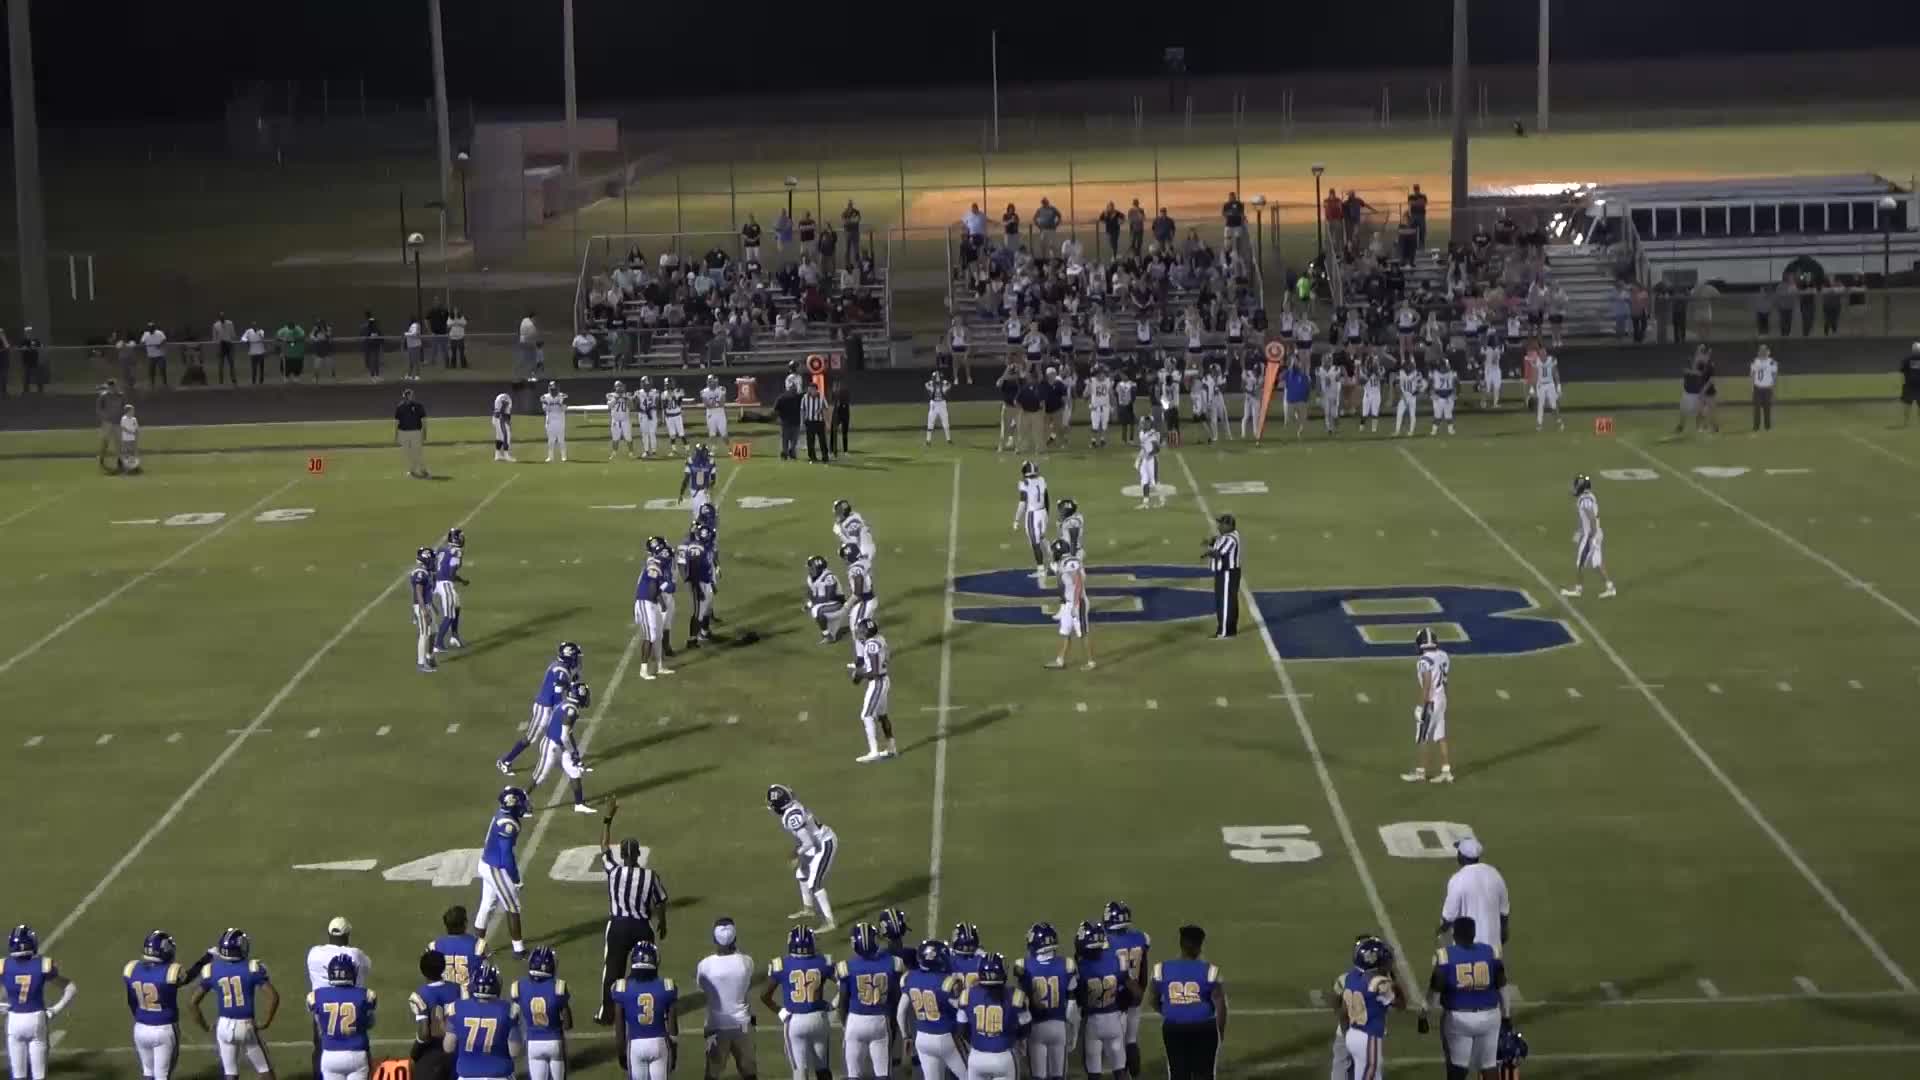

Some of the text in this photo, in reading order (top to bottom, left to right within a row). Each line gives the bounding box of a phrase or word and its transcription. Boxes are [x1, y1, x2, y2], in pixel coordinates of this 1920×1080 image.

[308, 458, 322, 471] 30
[733, 445, 748, 458] 40
[1222, 821, 1479, 863] 50
[15, 975, 32, 1004] 7
[217, 975, 244, 1008] 11
[1456, 961, 1491, 991] 50
[132, 981, 162, 1012] 12
[637, 992, 654, 1025] 3
[323, 1002, 357, 1036] 72
[463, 1016, 498, 1053] 77
